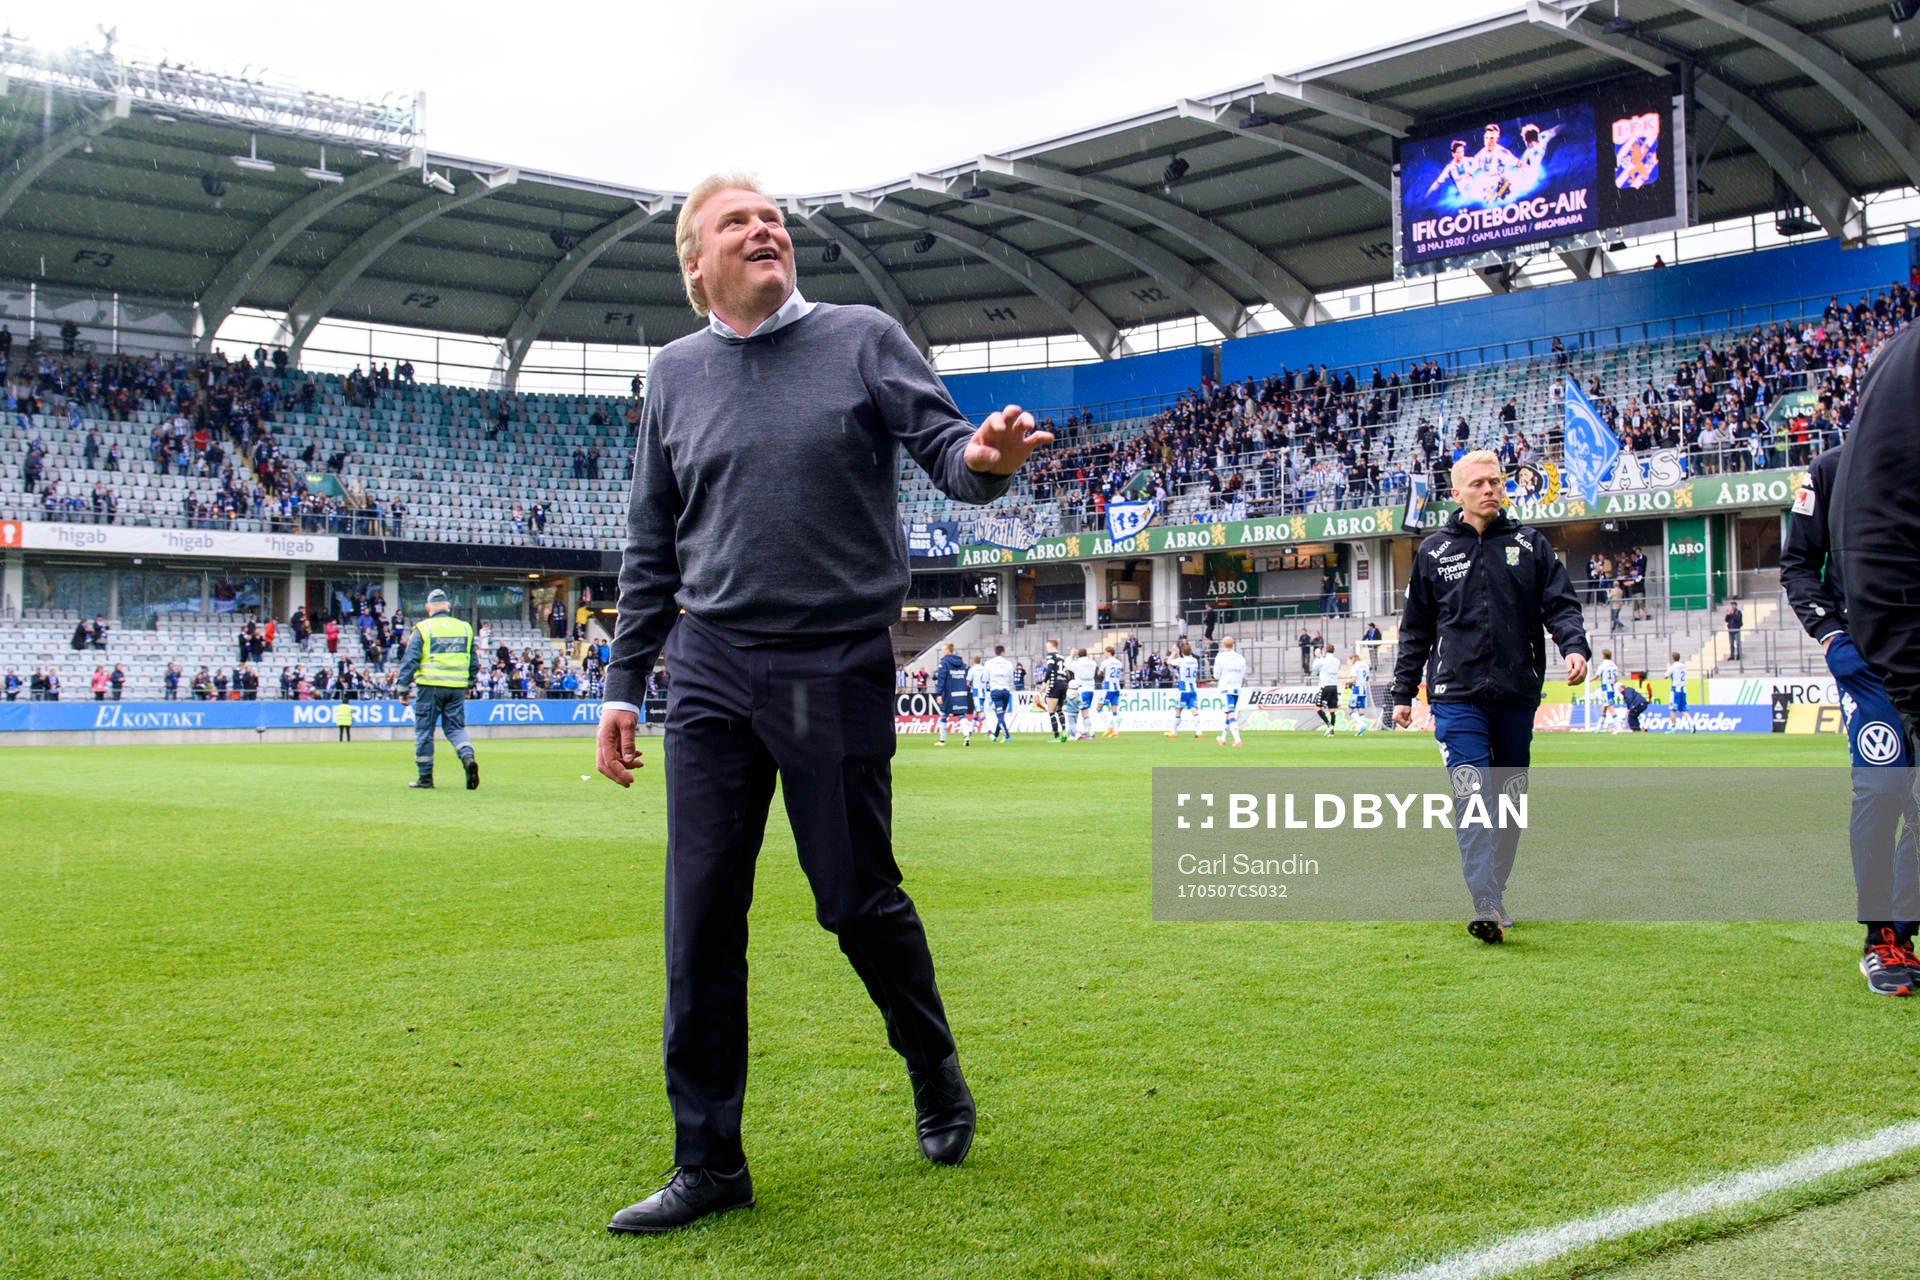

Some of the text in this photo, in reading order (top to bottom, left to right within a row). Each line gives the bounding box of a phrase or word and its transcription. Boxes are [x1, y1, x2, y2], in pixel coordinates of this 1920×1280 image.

[1412, 189, 1587, 242] IFK GÖTEBORG-AIK
[1417, 244, 1426, 253] 18
[1427, 239, 1444, 252] MAJ
[1445, 236, 1465, 248] 19.00
[1471, 229, 1500, 243] GAMLA
[1502, 224, 1527, 238] ULLEVI
[1515, 241, 1550, 255] SAMSUNG
[72, 249, 115, 268] F3
[402, 292, 440, 309] F2
[1131, 287, 1171, 303] H2
[603, 311, 635, 327] F1
[983, 306, 1018, 322] H1
[1716, 480, 1788, 504] ÅBRO
[1240, 524, 1290, 543] ÅBRO
[1323, 516, 1376, 536] ÅBRO
[57, 526, 107, 547] higab
[168, 532, 214, 551] higab
[271, 536, 314, 554] higab
[1164, 530, 1210, 549] ÅBRO
[962, 549, 1000, 566] ÅBRO
[1669, 542, 1704, 555] ÅBRO
[1207, 579, 1248, 596] ÅBRO
[95, 705, 205, 727] El KONTAKT
[294, 705, 383, 723] MORIS
[489, 704, 544, 721] ATEA
